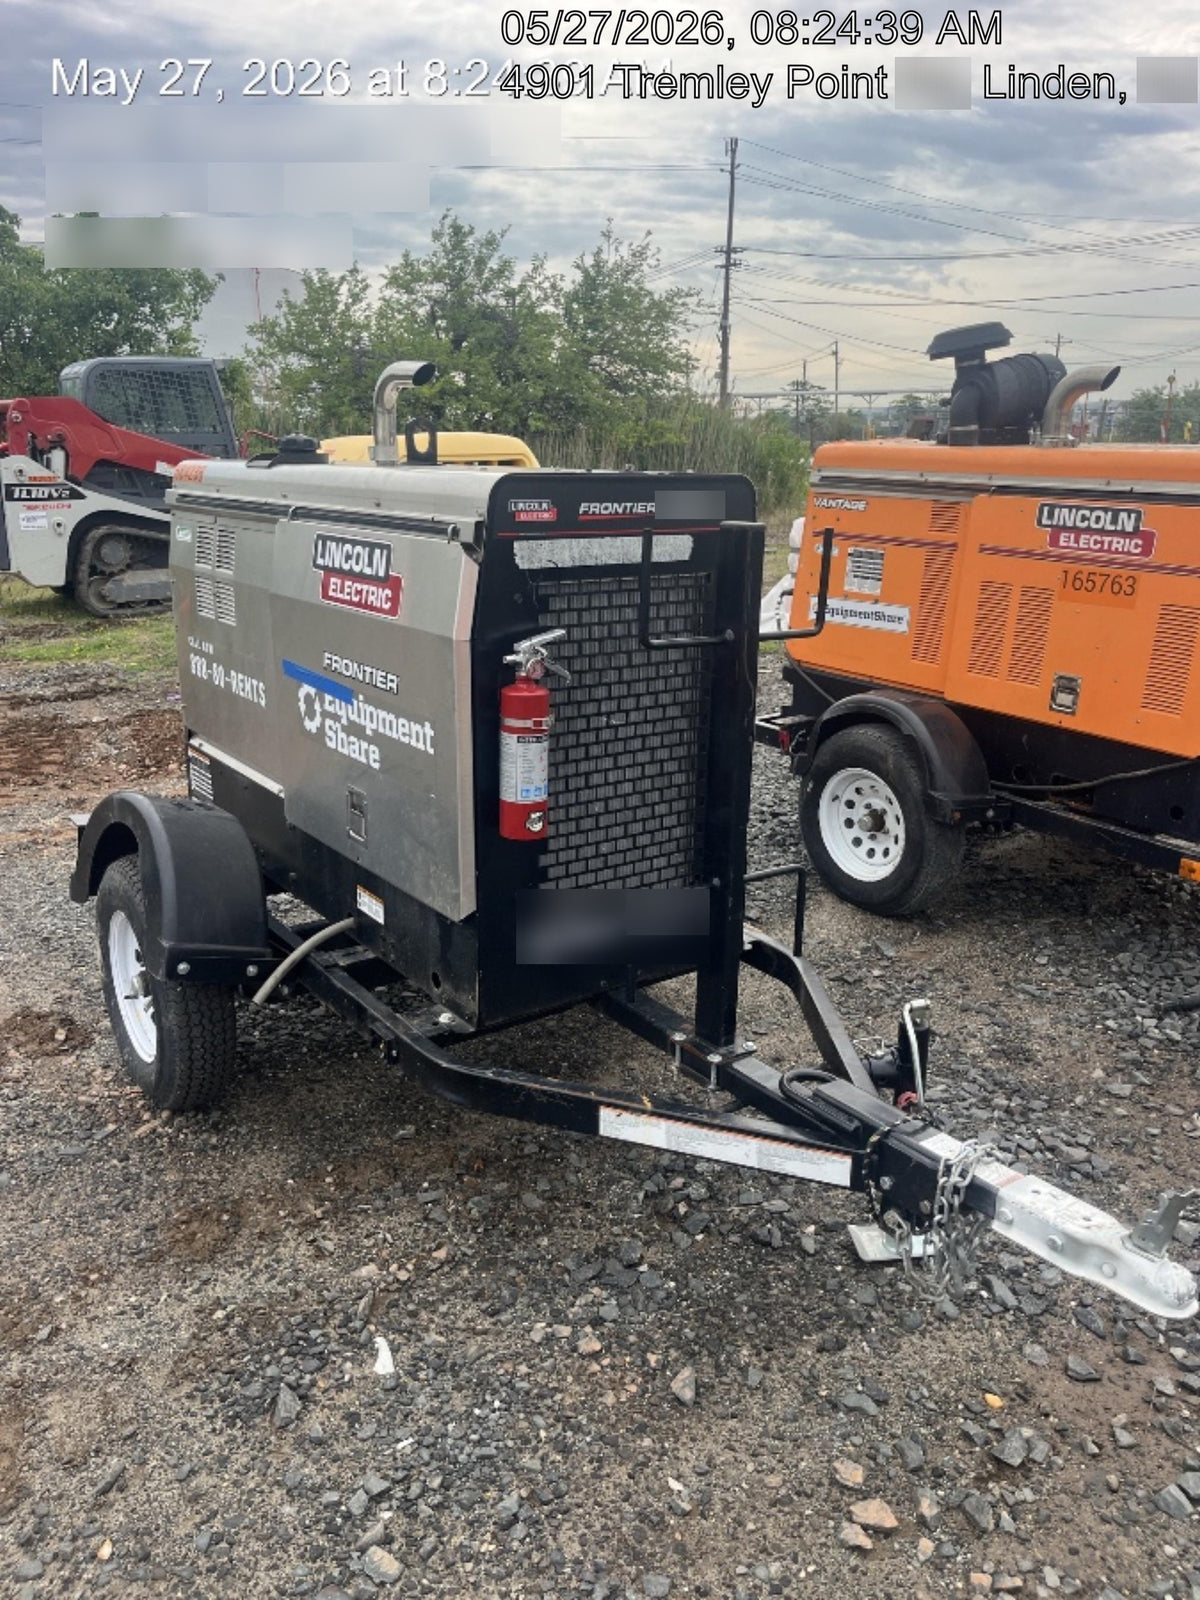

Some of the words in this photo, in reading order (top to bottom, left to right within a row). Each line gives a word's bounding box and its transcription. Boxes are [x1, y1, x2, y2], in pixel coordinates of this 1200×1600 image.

[579, 502, 655, 515] FRONTIER
[813, 498, 867, 511] VANTAGE
[1041, 506, 1137, 532] LINCOLN
[1059, 532, 1143, 554] ELECTRIC
[315, 539, 389, 578] LINCOLN
[328, 577, 392, 610] ELECTRIC
[1061, 570, 1137, 597] 165763
[323, 652, 399, 694] FRONTIER
[324, 690, 435, 756] Equipment
[325, 718, 381, 770] Share
